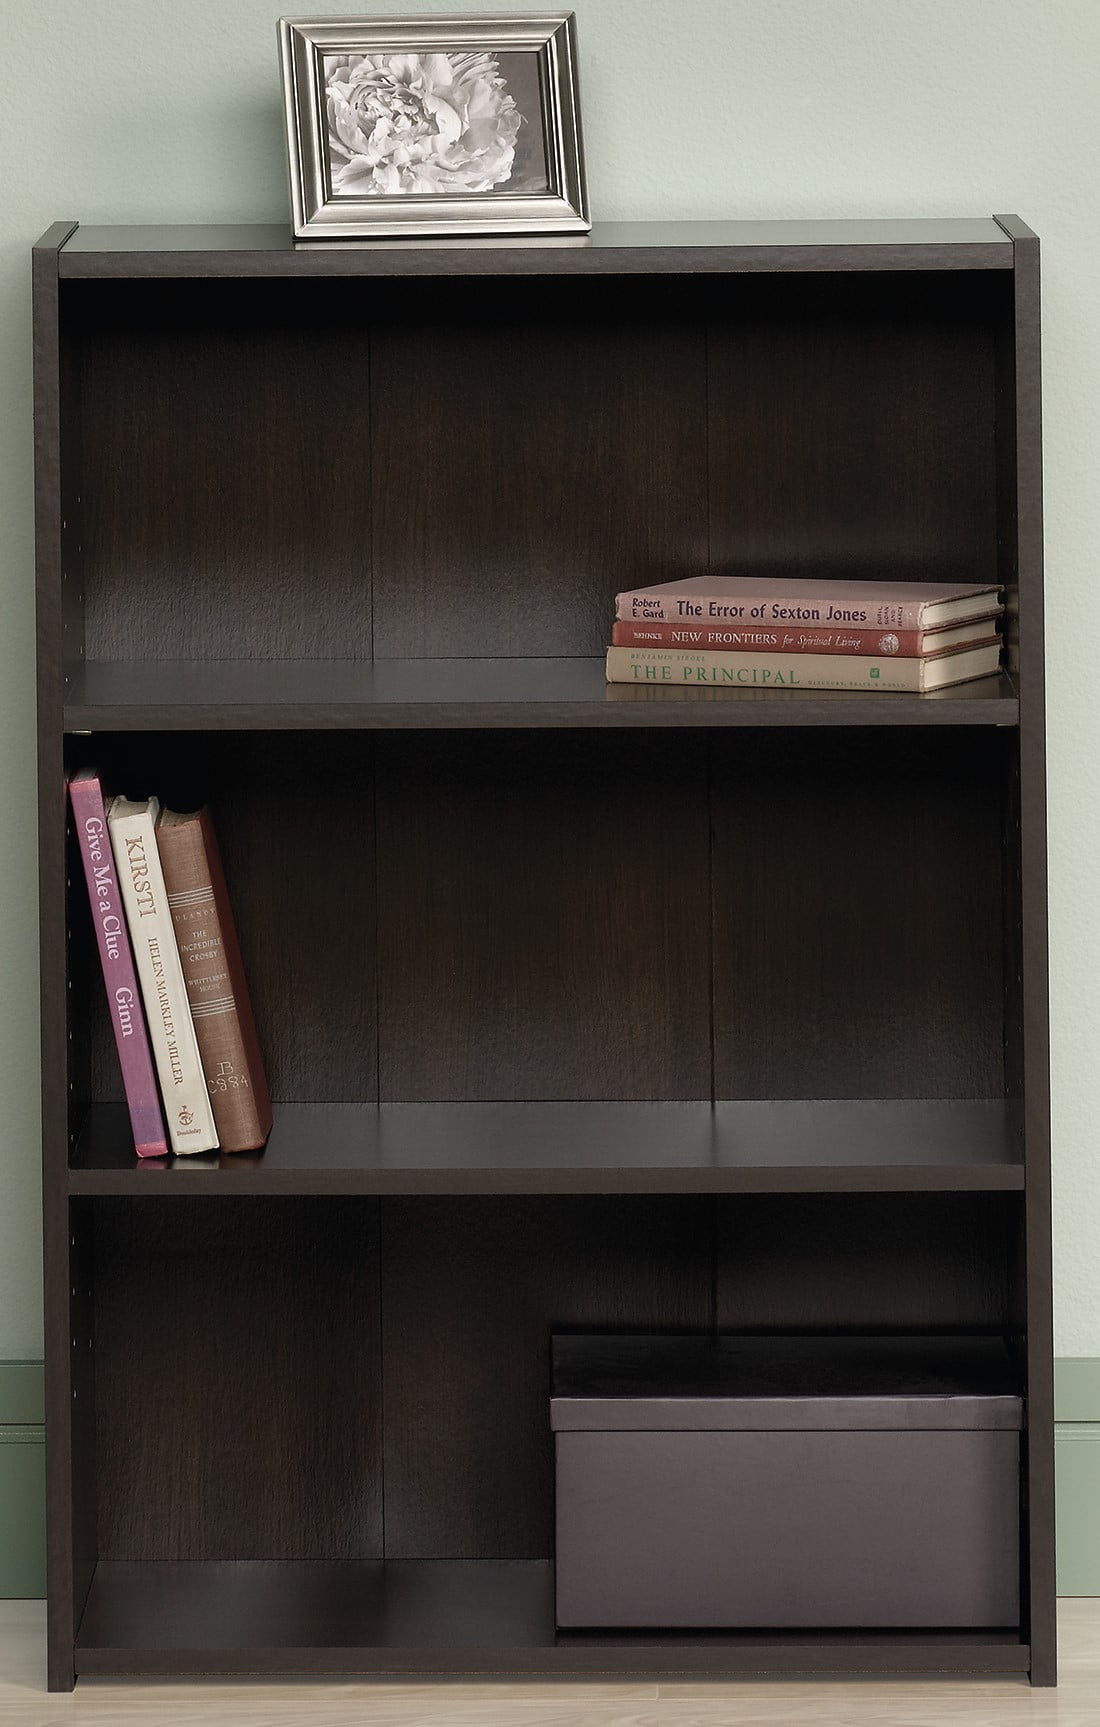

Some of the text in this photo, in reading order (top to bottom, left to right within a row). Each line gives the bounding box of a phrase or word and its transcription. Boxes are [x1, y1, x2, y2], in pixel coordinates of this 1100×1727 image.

[632, 598, 661, 608] Robert
[676, 601, 867, 622] The Error of Sexton Jones
[632, 609, 664, 618] E. Gard
[671, 631, 861, 650] NEW FRONTIERS for Spiritual Living
[631, 664, 800, 684] THE PRINCIPAL
[125, 835, 157, 917] KIRSTI
[85, 816, 134, 1039] Give Me a Clue Ginn
[192, 930, 207, 938] THE
[181, 937, 222, 952] INCREDIBLE
[189, 950, 218, 962] CROSBY
[148, 936, 184, 1085] HELEN MARKLEY MILLER
[216, 1061, 233, 1077] B
